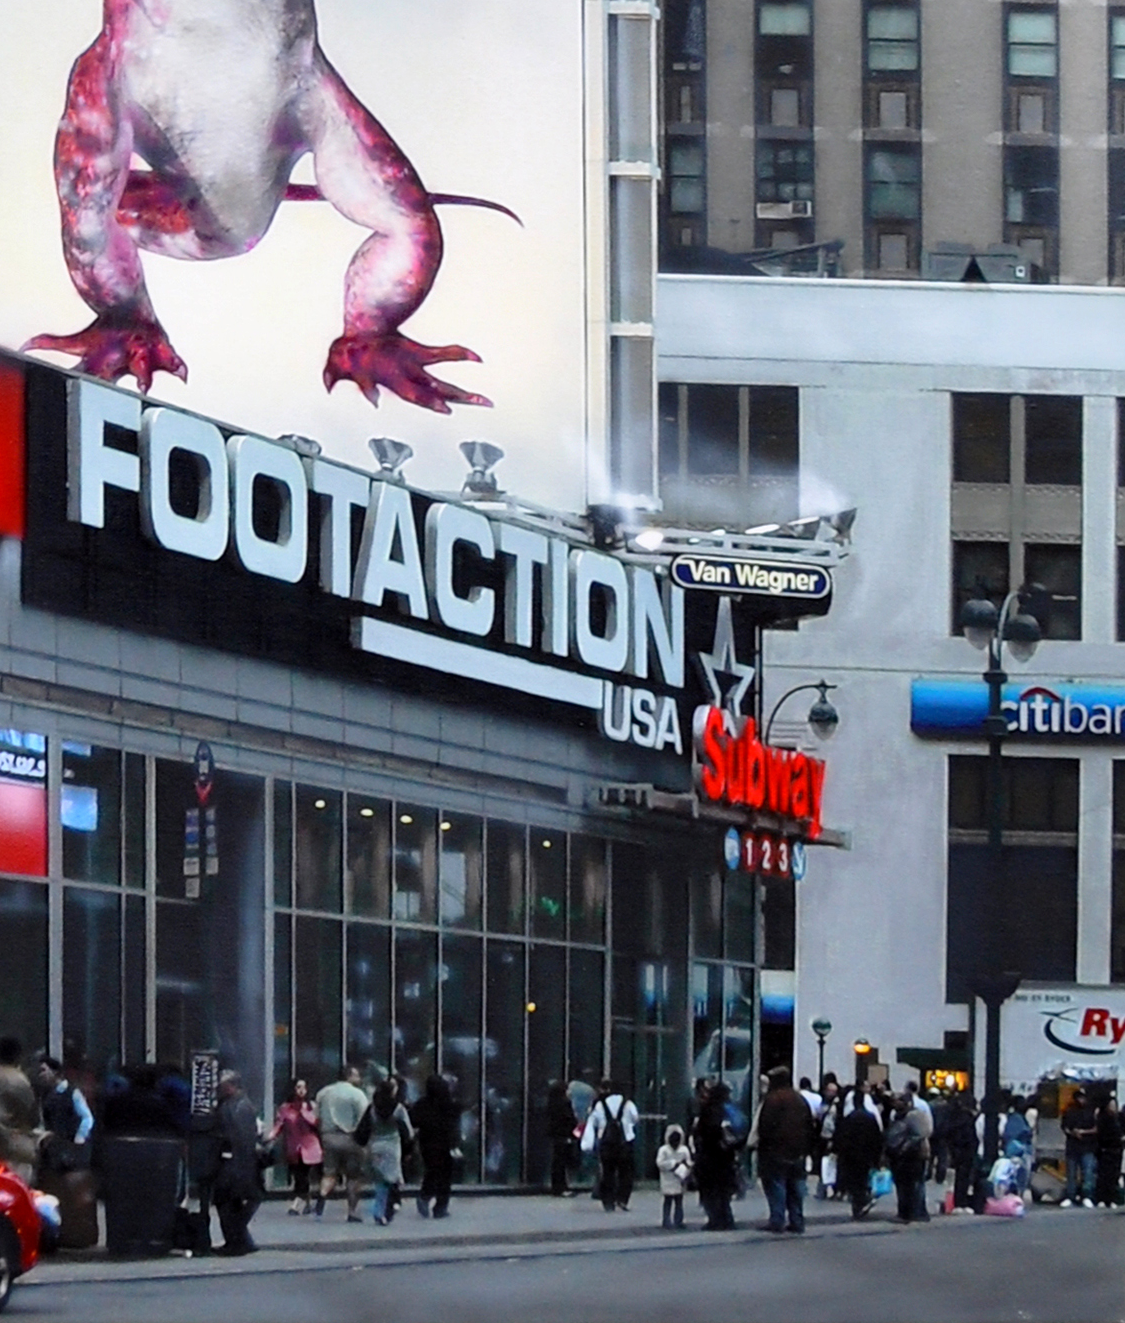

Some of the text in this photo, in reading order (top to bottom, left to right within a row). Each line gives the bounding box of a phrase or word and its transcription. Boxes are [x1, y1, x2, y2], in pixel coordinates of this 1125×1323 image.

[67, 379, 685, 687] FOOTACTION
[687, 560, 818, 594] Van Wagner
[601, 678, 683, 755] USA
[695, 704, 825, 840] Subway
